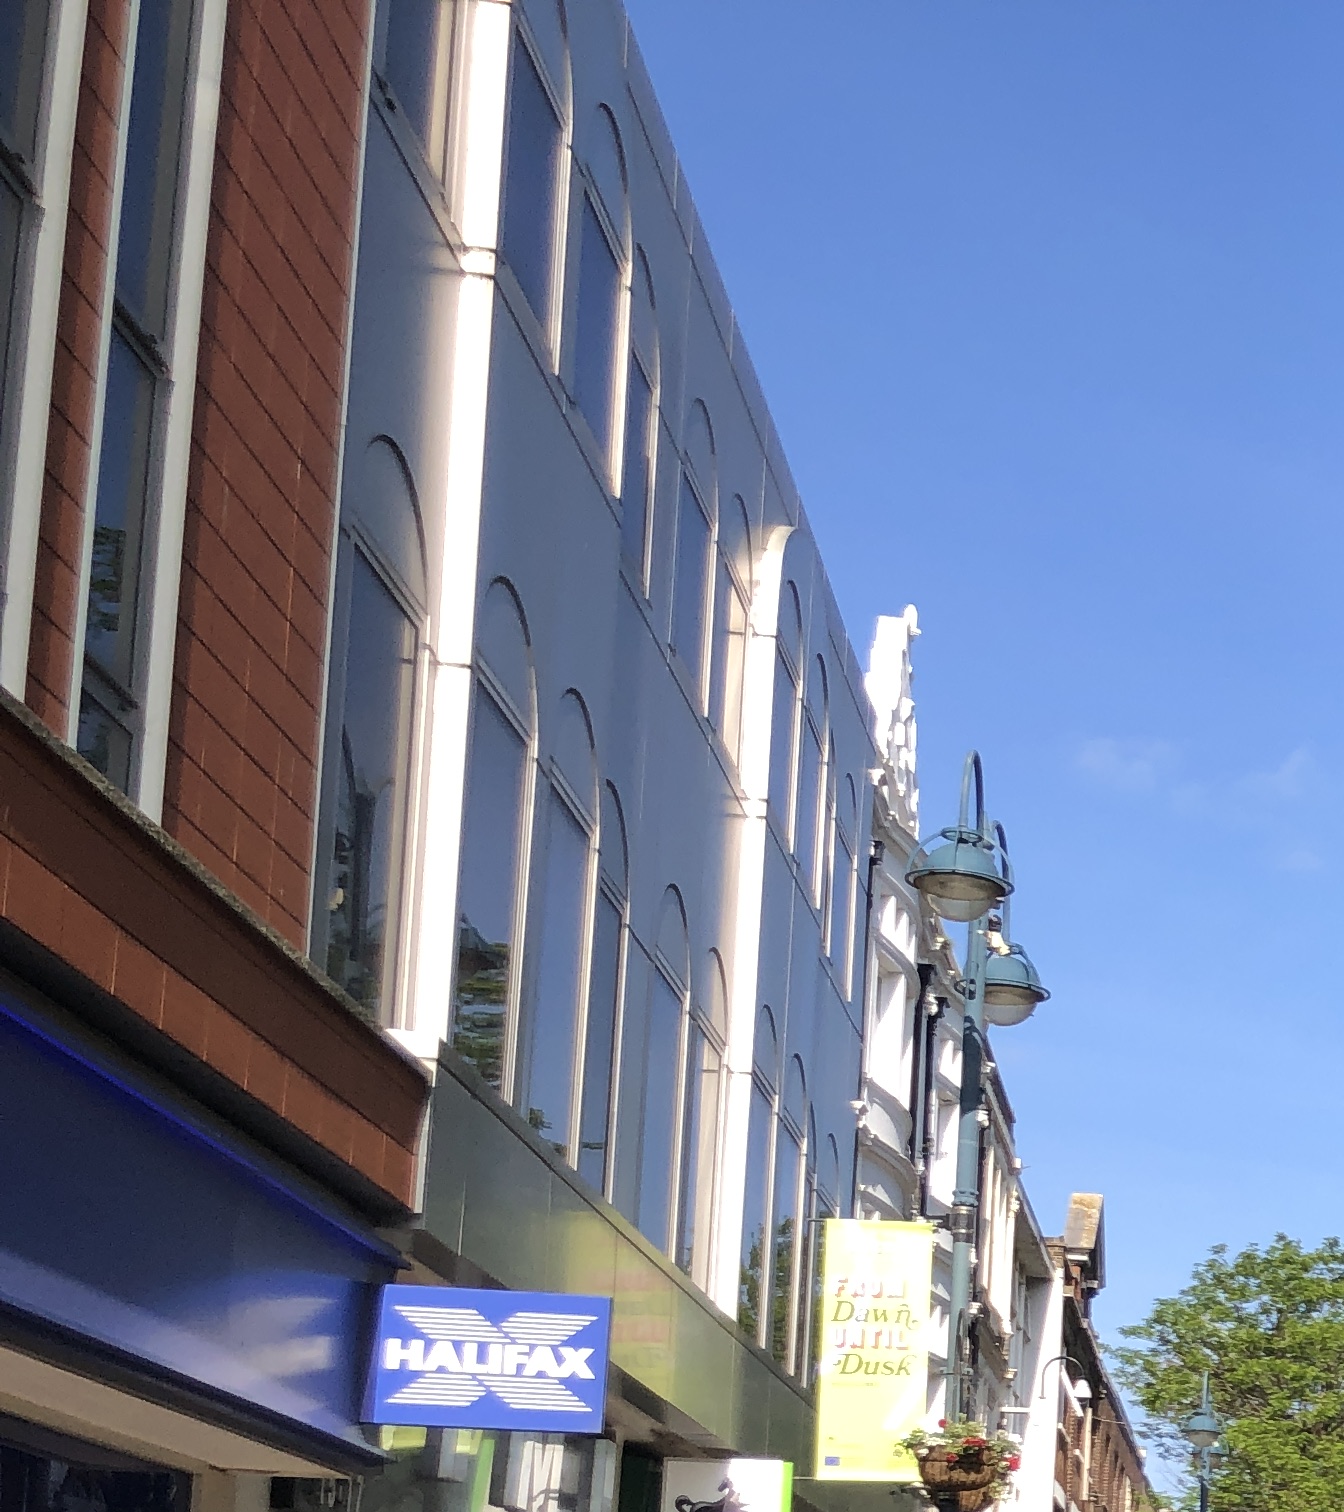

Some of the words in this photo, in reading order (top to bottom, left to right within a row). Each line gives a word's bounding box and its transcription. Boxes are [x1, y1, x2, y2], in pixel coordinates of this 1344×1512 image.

[831, 1301, 919, 1330] Dawn
[383, 1338, 596, 1380] HALIFAX
[833, 1353, 917, 1375] Dusk
